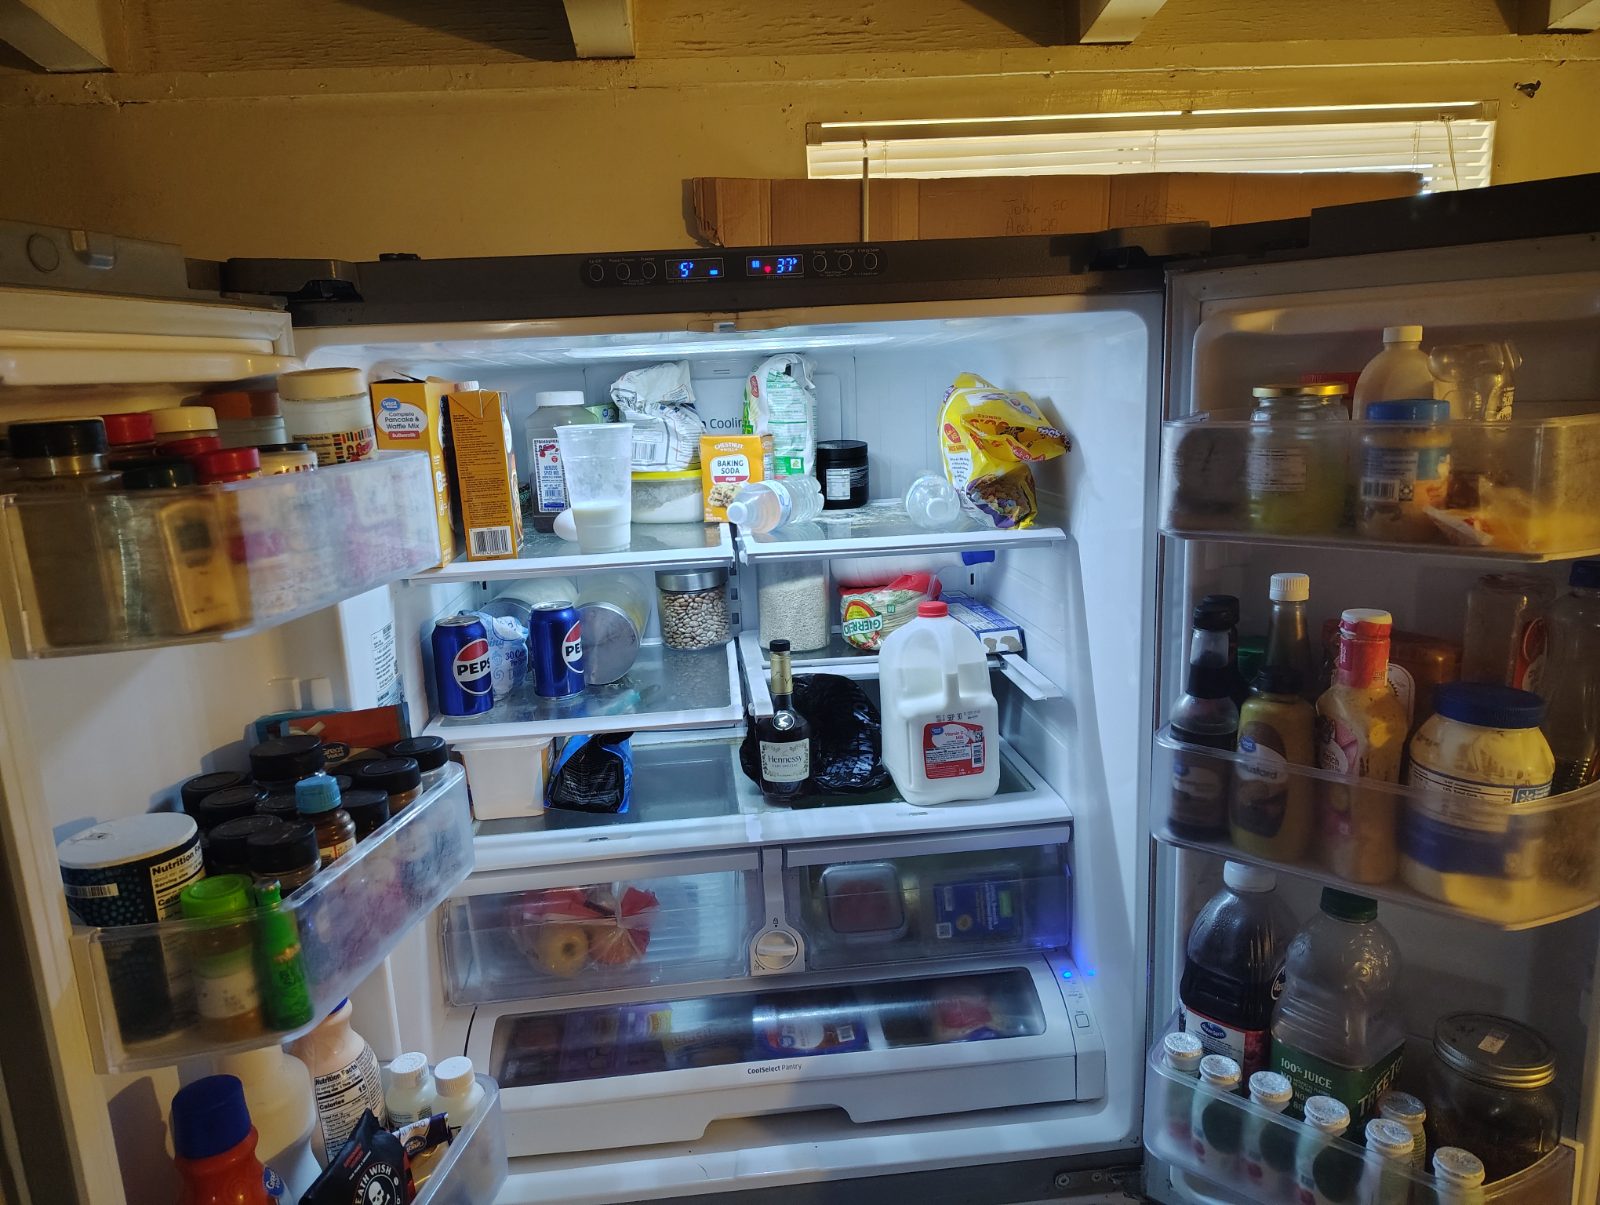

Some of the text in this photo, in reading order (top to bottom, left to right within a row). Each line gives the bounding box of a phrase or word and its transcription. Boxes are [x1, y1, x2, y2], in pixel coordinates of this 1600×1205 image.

[717, 459, 744, 467] BAKING
[720, 467, 740, 475] SODA
[768, 755, 802, 764] Hennessy
[152, 852, 195, 876] Nutrition
[747, 1063, 802, 1074] CoolSelect Pantry
[315, 1073, 341, 1086] Nutrition
[341, 1064, 358, 1076] Facts
[1303, 1070, 1333, 1090] JUICE
[359, 1084, 367, 1093] 15
[319, 1099, 345, 1110] Calories
[369, 1164, 392, 1176] WISH
